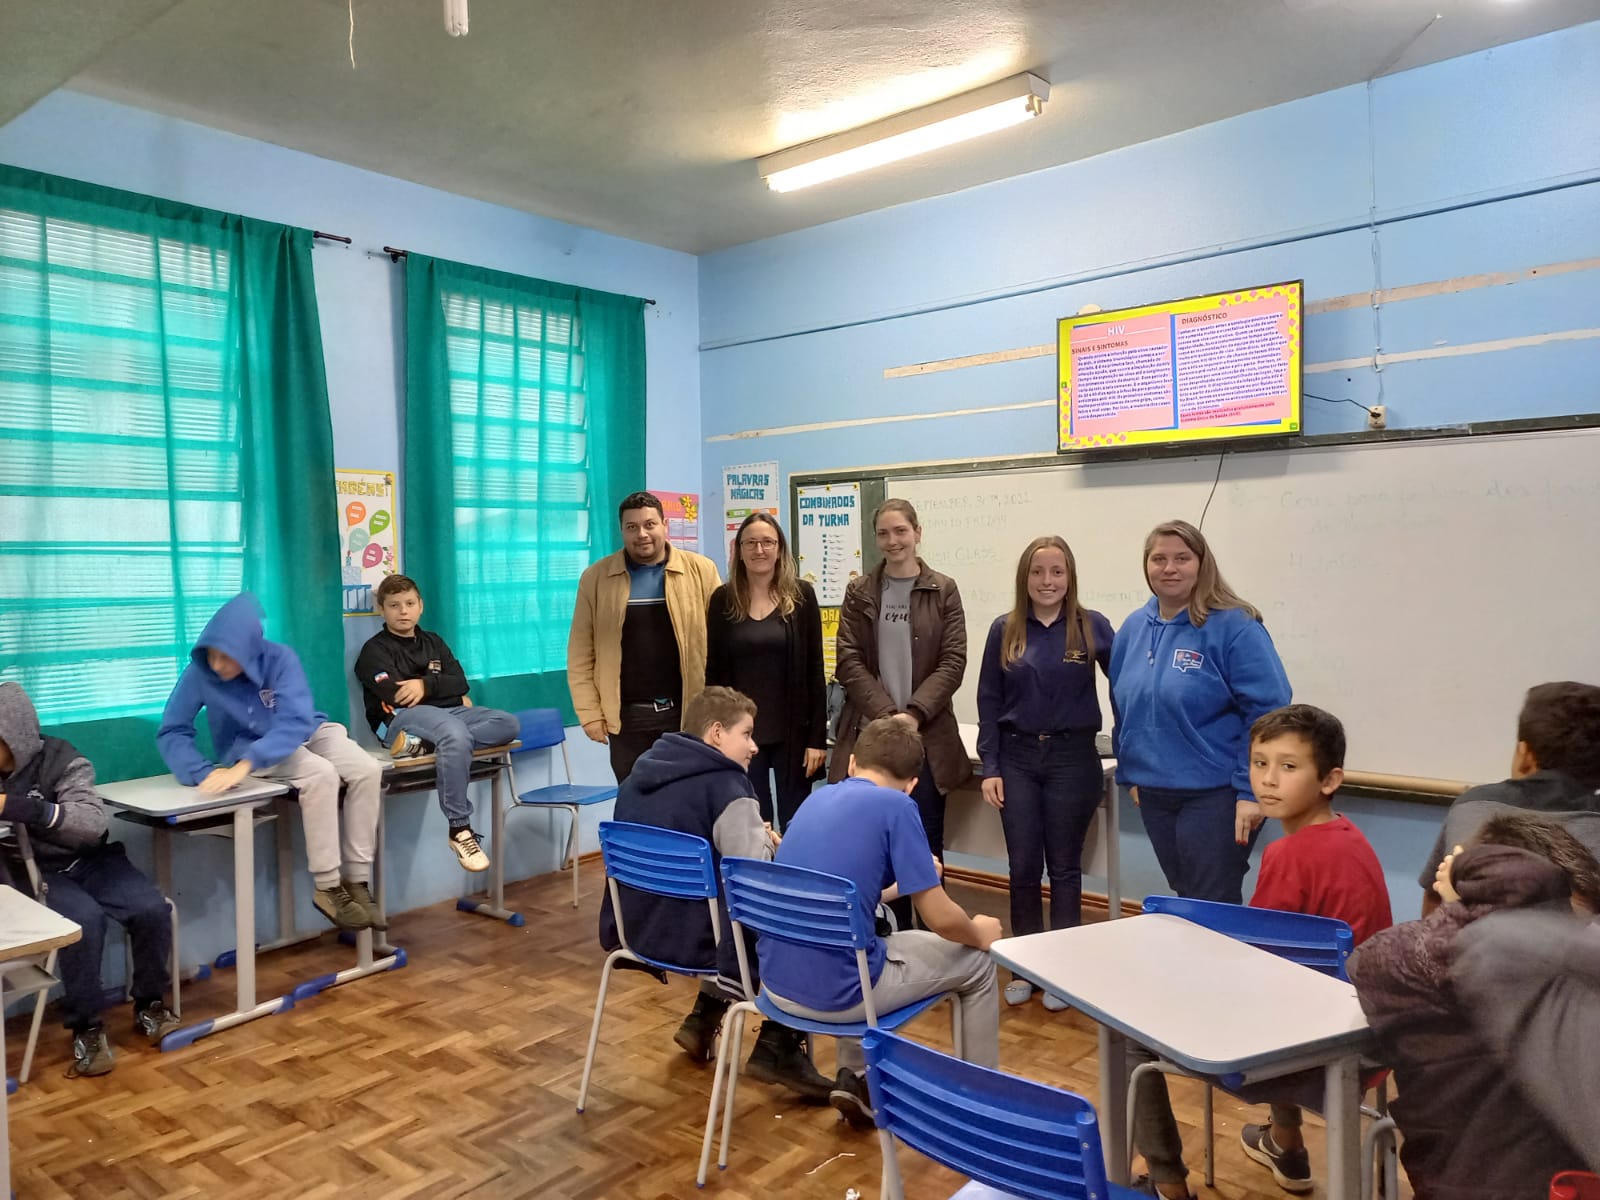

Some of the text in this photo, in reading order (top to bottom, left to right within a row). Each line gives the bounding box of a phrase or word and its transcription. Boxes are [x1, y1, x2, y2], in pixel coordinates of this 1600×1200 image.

[1181, 312, 1228, 325] DIAGNÓSTICO
[1107, 325, 1125, 336] HIV
[1072, 345, 1091, 354] SINAIS
[1097, 341, 1128, 350] SINTOMAS
[727, 474, 770, 486] PALAVRAS
[731, 486, 765, 500] MÁGICAS
[800, 495, 855, 509] COMBINADOS
[803, 514, 849, 527] DA TURMA
